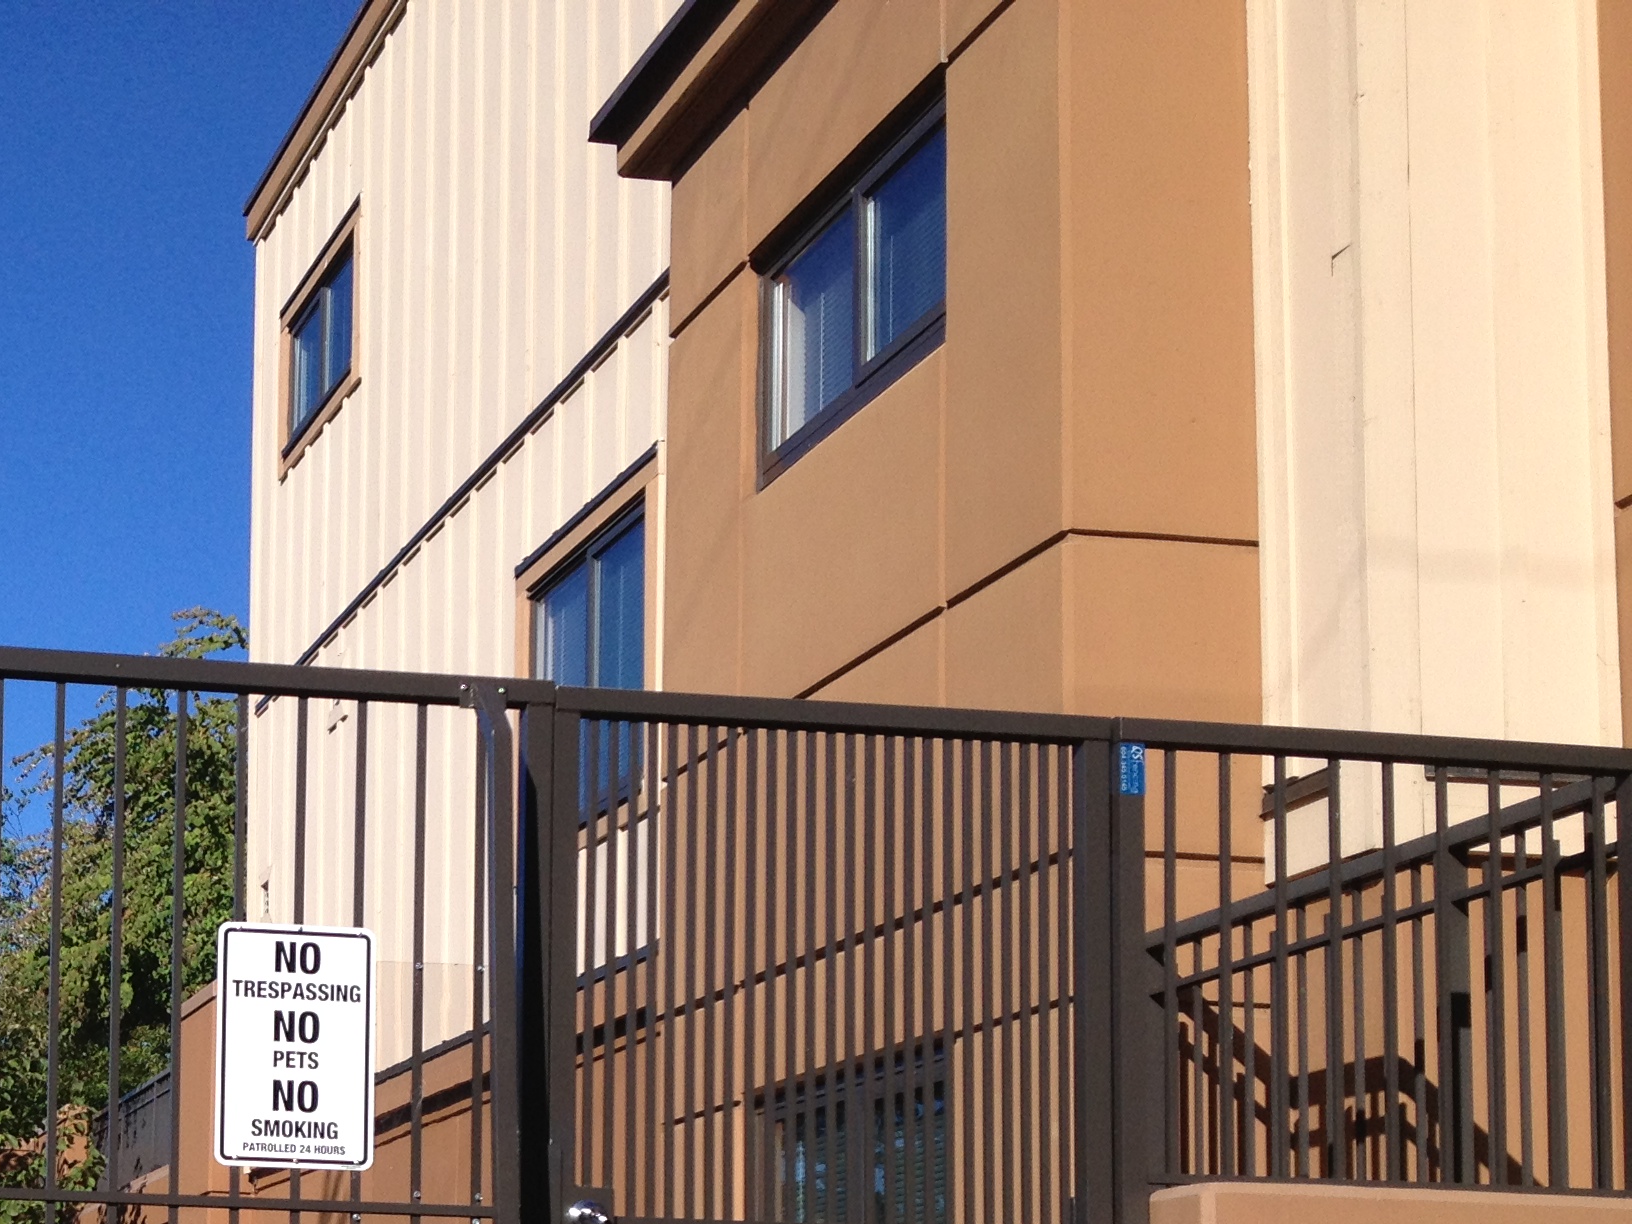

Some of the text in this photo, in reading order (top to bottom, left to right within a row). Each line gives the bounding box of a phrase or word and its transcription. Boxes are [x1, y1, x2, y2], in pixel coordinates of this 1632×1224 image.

[274, 940, 321, 975] NO
[232, 979, 361, 1003] TRESPASSING
[273, 1009, 320, 1044] NO
[273, 1050, 319, 1070] PETS
[272, 1079, 319, 1113] NO
[251, 1118, 339, 1140] SMOKING
[242, 1142, 346, 1156] PATROLLED 24 HOURS
